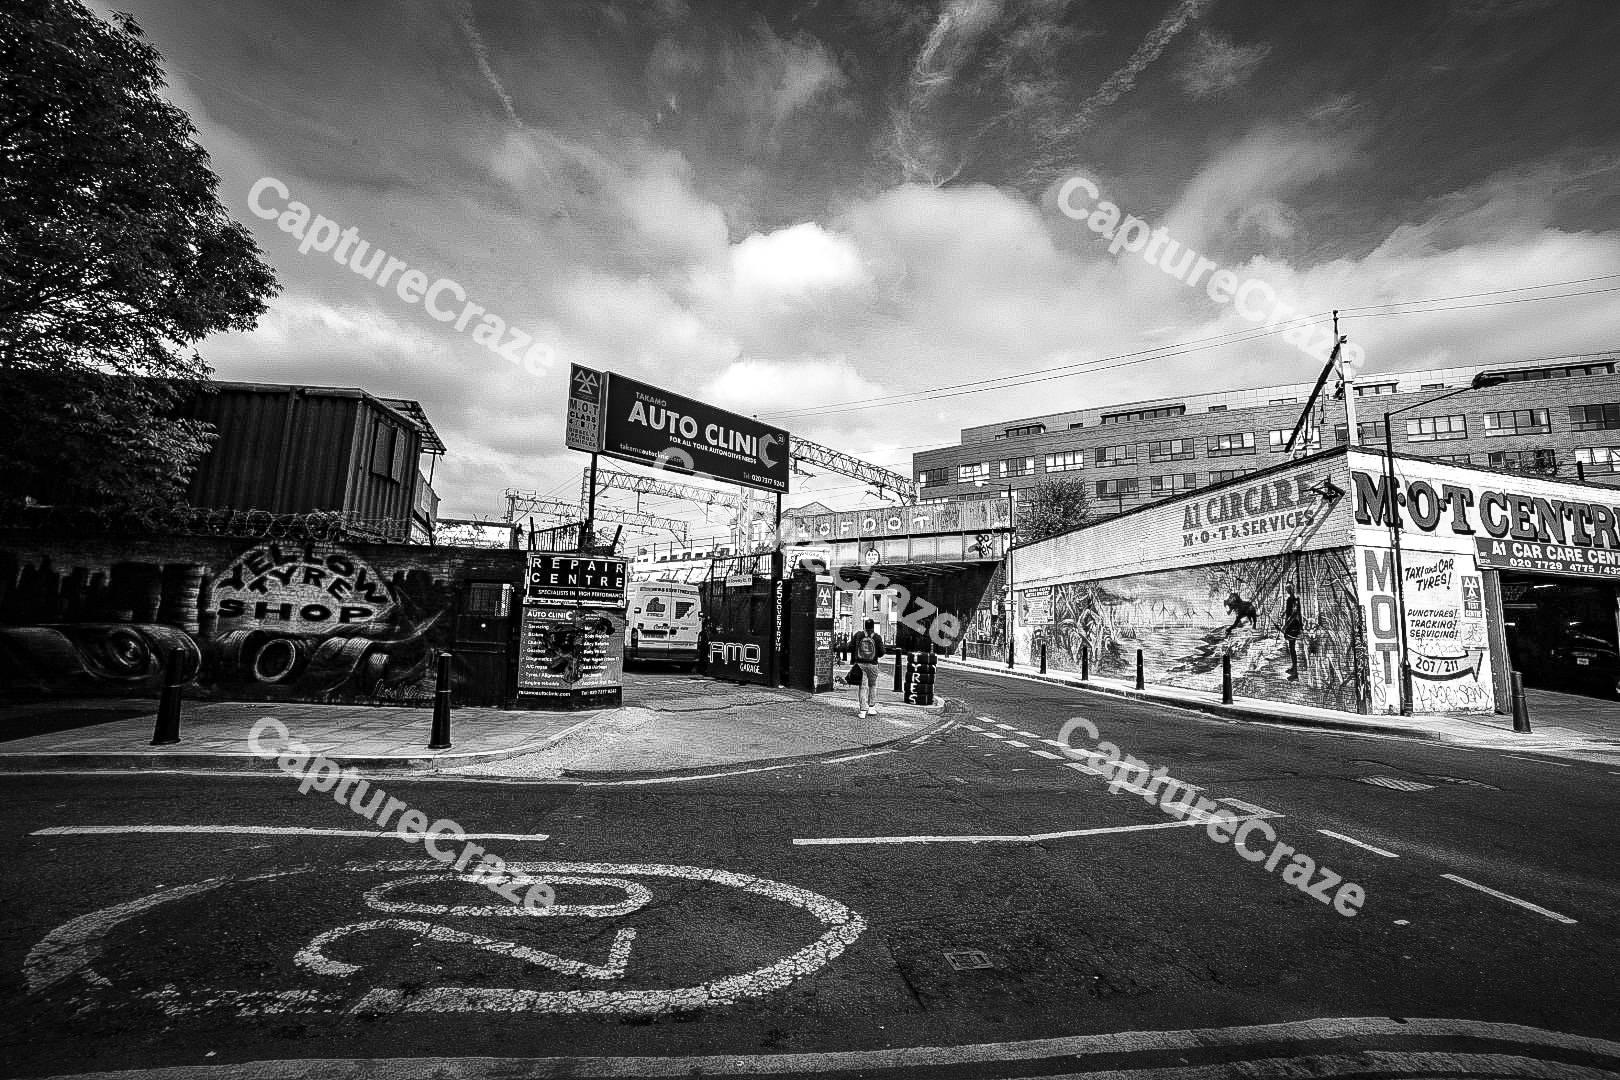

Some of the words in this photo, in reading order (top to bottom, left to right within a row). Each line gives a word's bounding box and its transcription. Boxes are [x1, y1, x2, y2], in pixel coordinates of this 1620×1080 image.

[636, 392, 667, 407] TAKAMO
[570, 411, 597, 423] CLASS
[628, 401, 698, 438] AUTO
[705, 424, 779, 469] CLINIC
[670, 436, 681, 444] FOR
[693, 442, 708, 451] YOUR
[751, 474, 761, 482] 020
[1183, 502, 1202, 530] A1
[1232, 524, 1241, 538] &
[1242, 509, 1314, 537] SERVICES
[1479, 491, 1620, 549] CENTR
[1492, 541, 1506, 555] A1
[1512, 542, 1542, 558] CAR
[1546, 545, 1584, 562] CARE
[216, 542, 389, 604] YELLOW
[533, 557, 623, 573] REPAIR
[1405, 566, 1424, 581] TAXI
[1425, 563, 1437, 574] and
[1439, 558, 1454, 573] CAR
[1509, 557, 1532, 568] 020
[1535, 560, 1562, 570] 7729
[1570, 563, 1594, 573] 4775
[247, 565, 352, 601] TYRE
[531, 572, 623, 587] CENTRE
[1416, 571, 1452, 591] TYRES!
[216, 599, 374, 624] SHOP
[1364, 549, 1399, 684] MOT
[1407, 609, 1458, 618] PUNCTURES!
[1410, 619, 1458, 630] TRACKING!
[1409, 629, 1459, 639] SERVICING!
[740, 663, 761, 674] GARAGE
[1416, 657, 1459, 674] 207/211
[909, 652, 921, 705] TYRES
